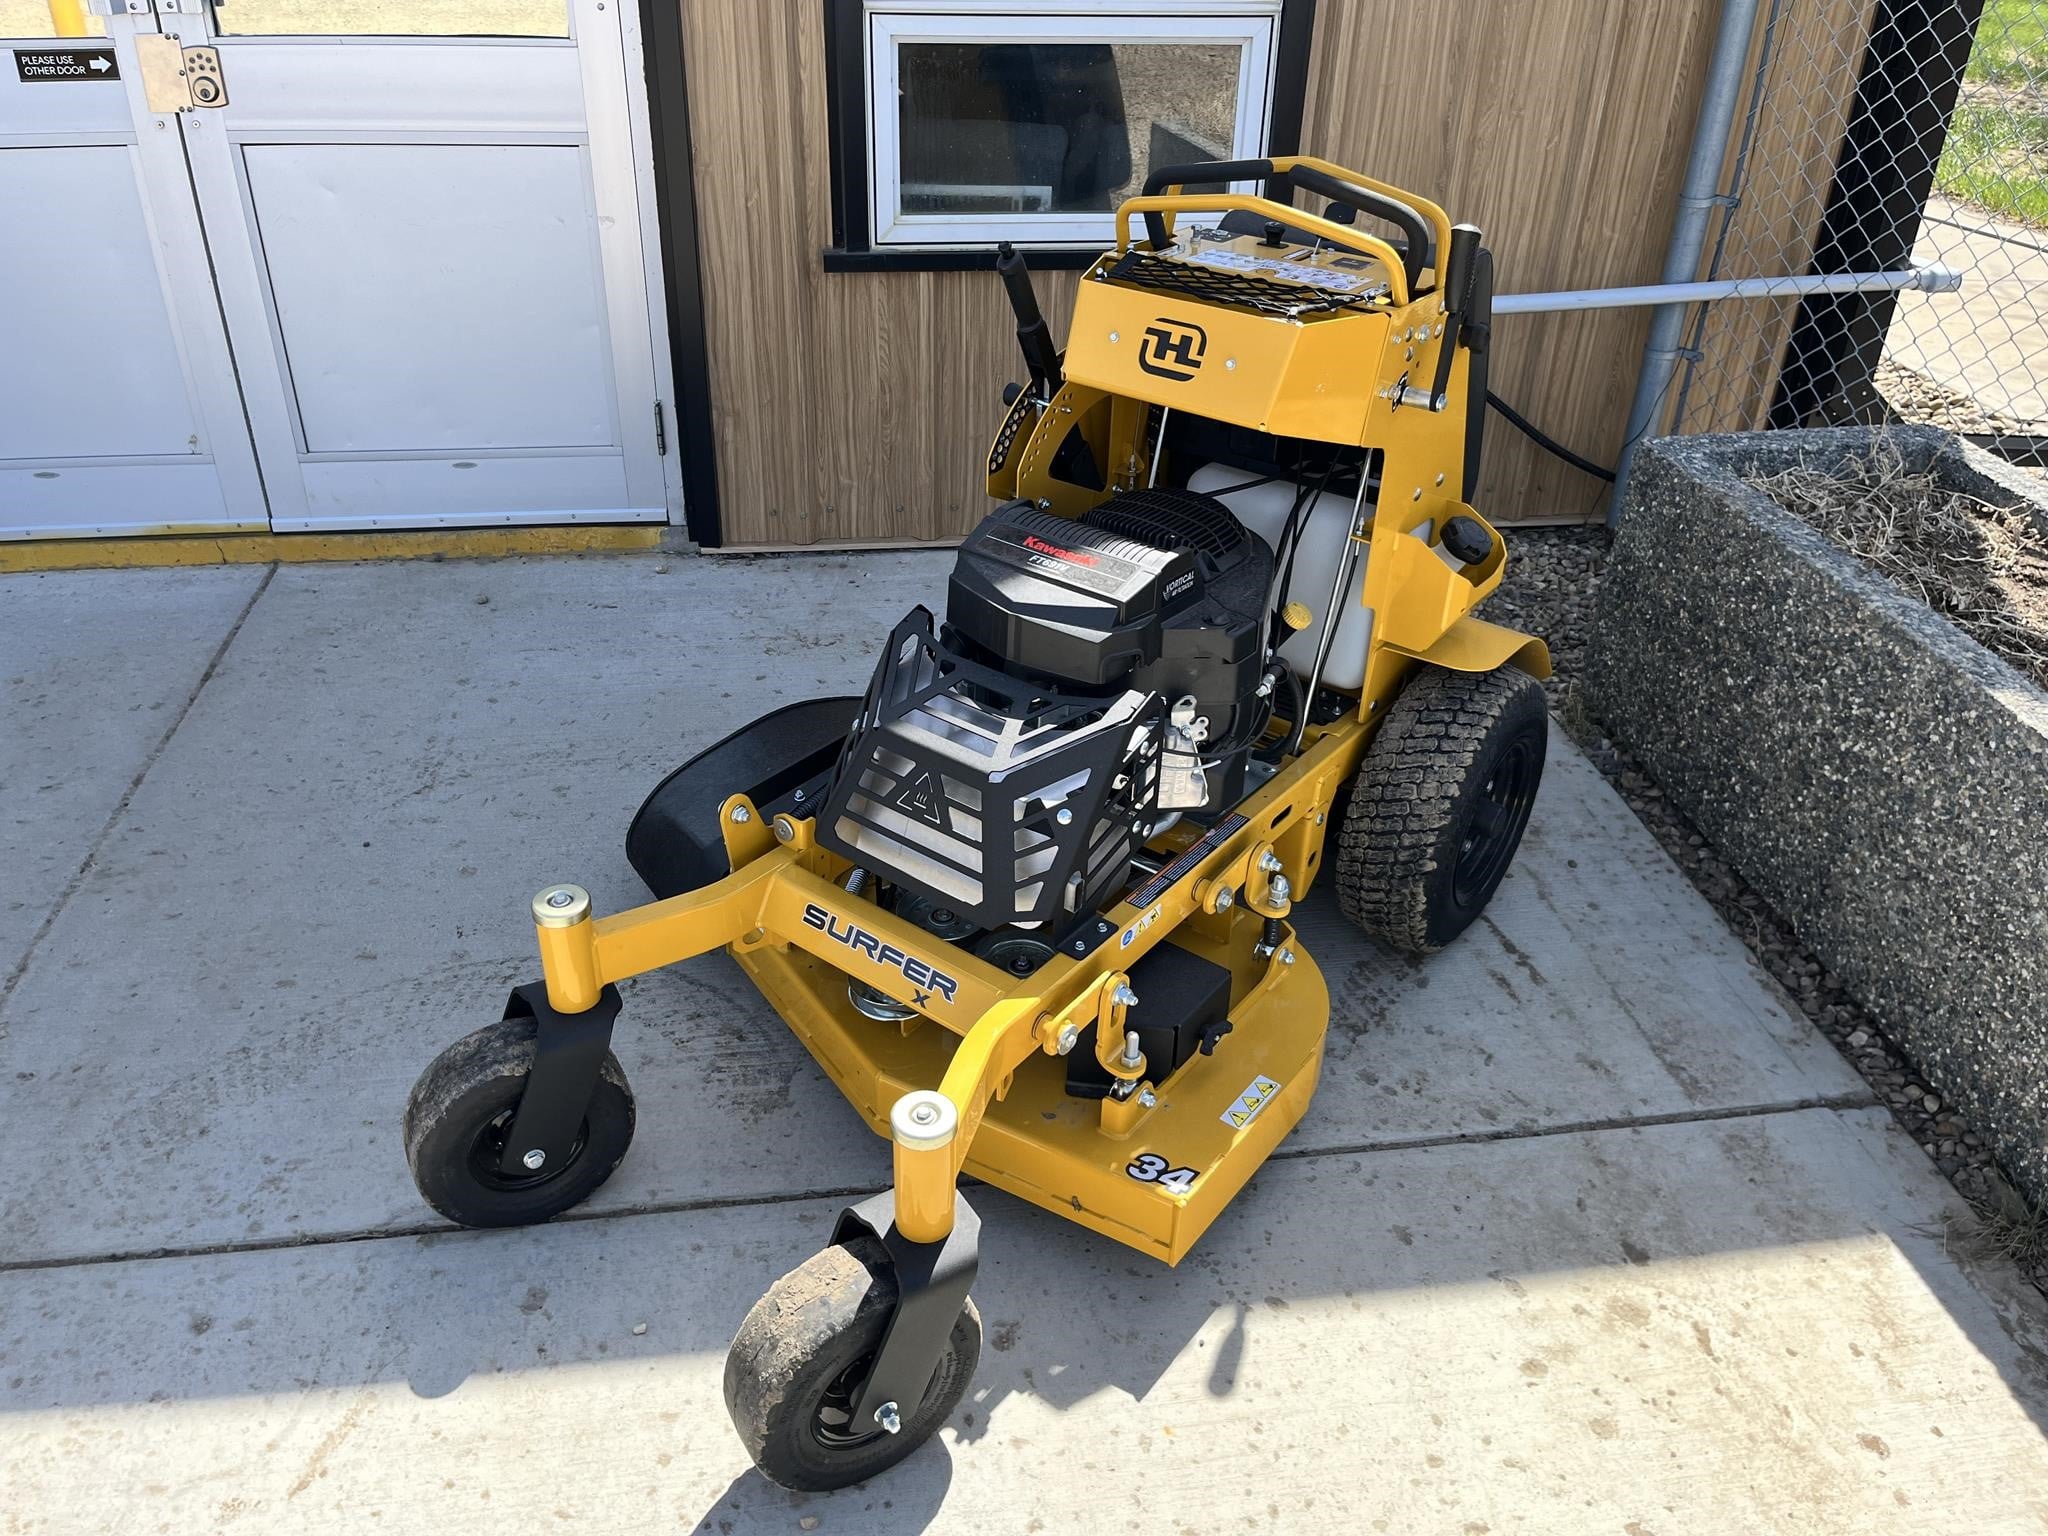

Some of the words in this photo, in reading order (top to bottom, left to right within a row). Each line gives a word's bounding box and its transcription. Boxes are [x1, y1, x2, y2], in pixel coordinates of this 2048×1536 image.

[21, 56, 56, 65] PLEASE
[57, 56, 74, 65] USE
[24, 66, 57, 76] OTHER
[57, 66, 87, 75] DOOR
[1028, 554, 1070, 572] FT691V
[801, 902, 959, 1005] SURFER
[911, 988, 930, 1010] X
[1125, 1153, 1201, 1195] 34
